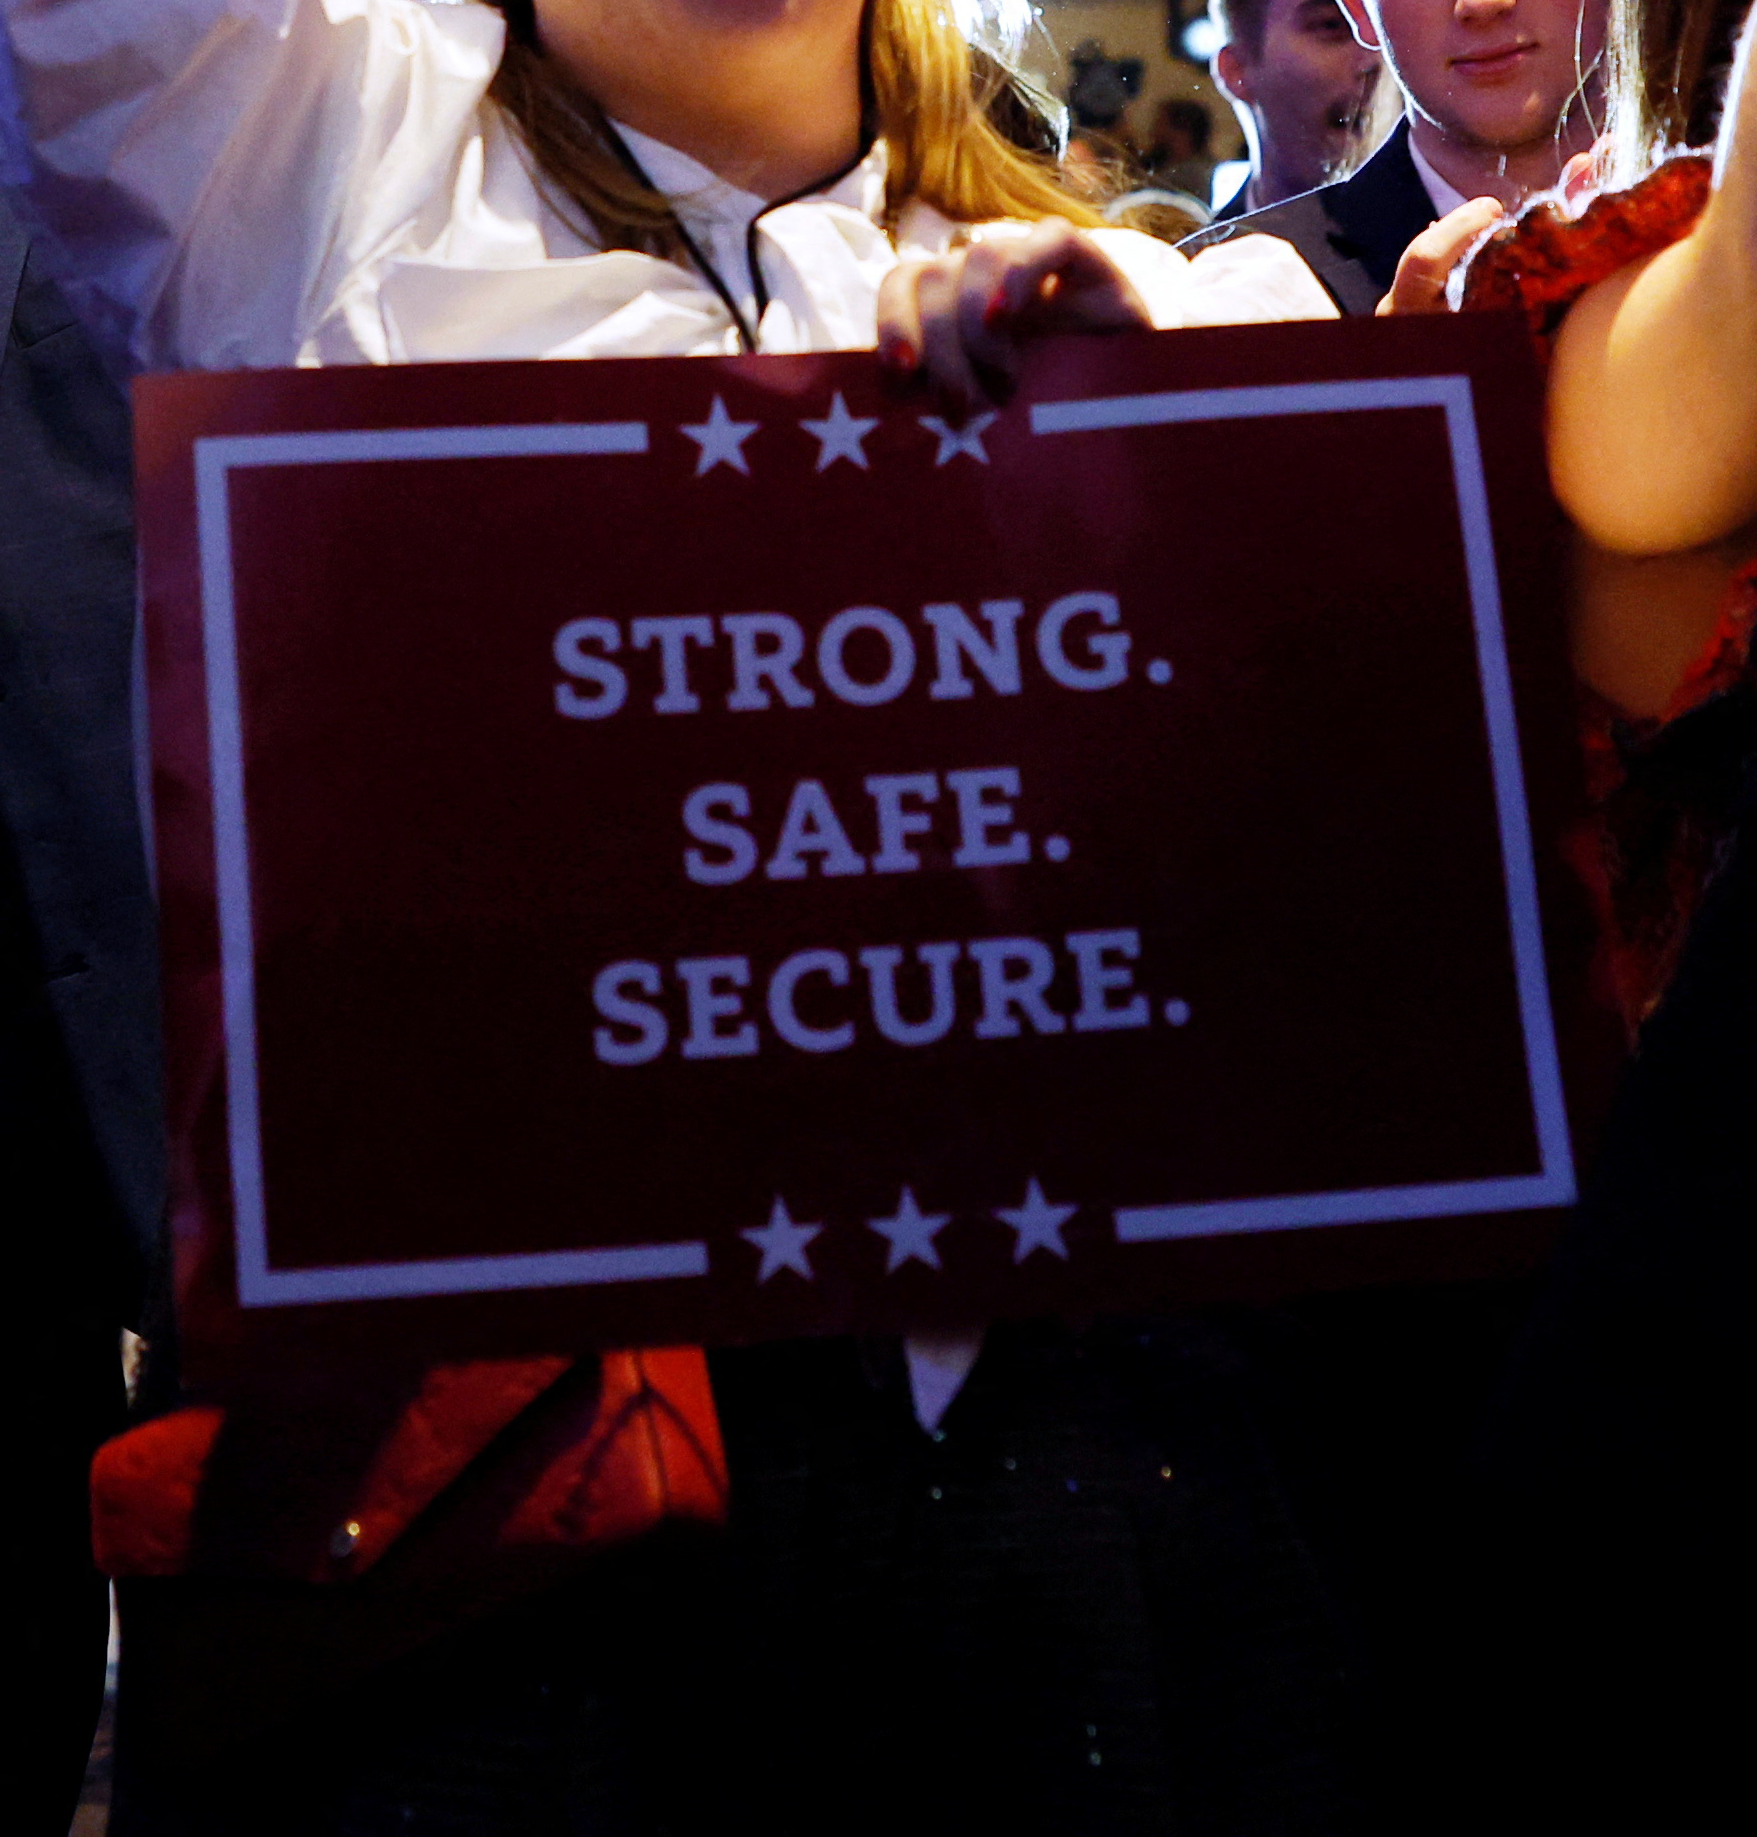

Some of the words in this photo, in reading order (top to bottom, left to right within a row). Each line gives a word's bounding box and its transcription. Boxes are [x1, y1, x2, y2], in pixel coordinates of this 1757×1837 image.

[553, 591, 1172, 719] STRONG.
[682, 767, 1070, 885] SAFE.
[592, 929, 1190, 1065] SECURE.
